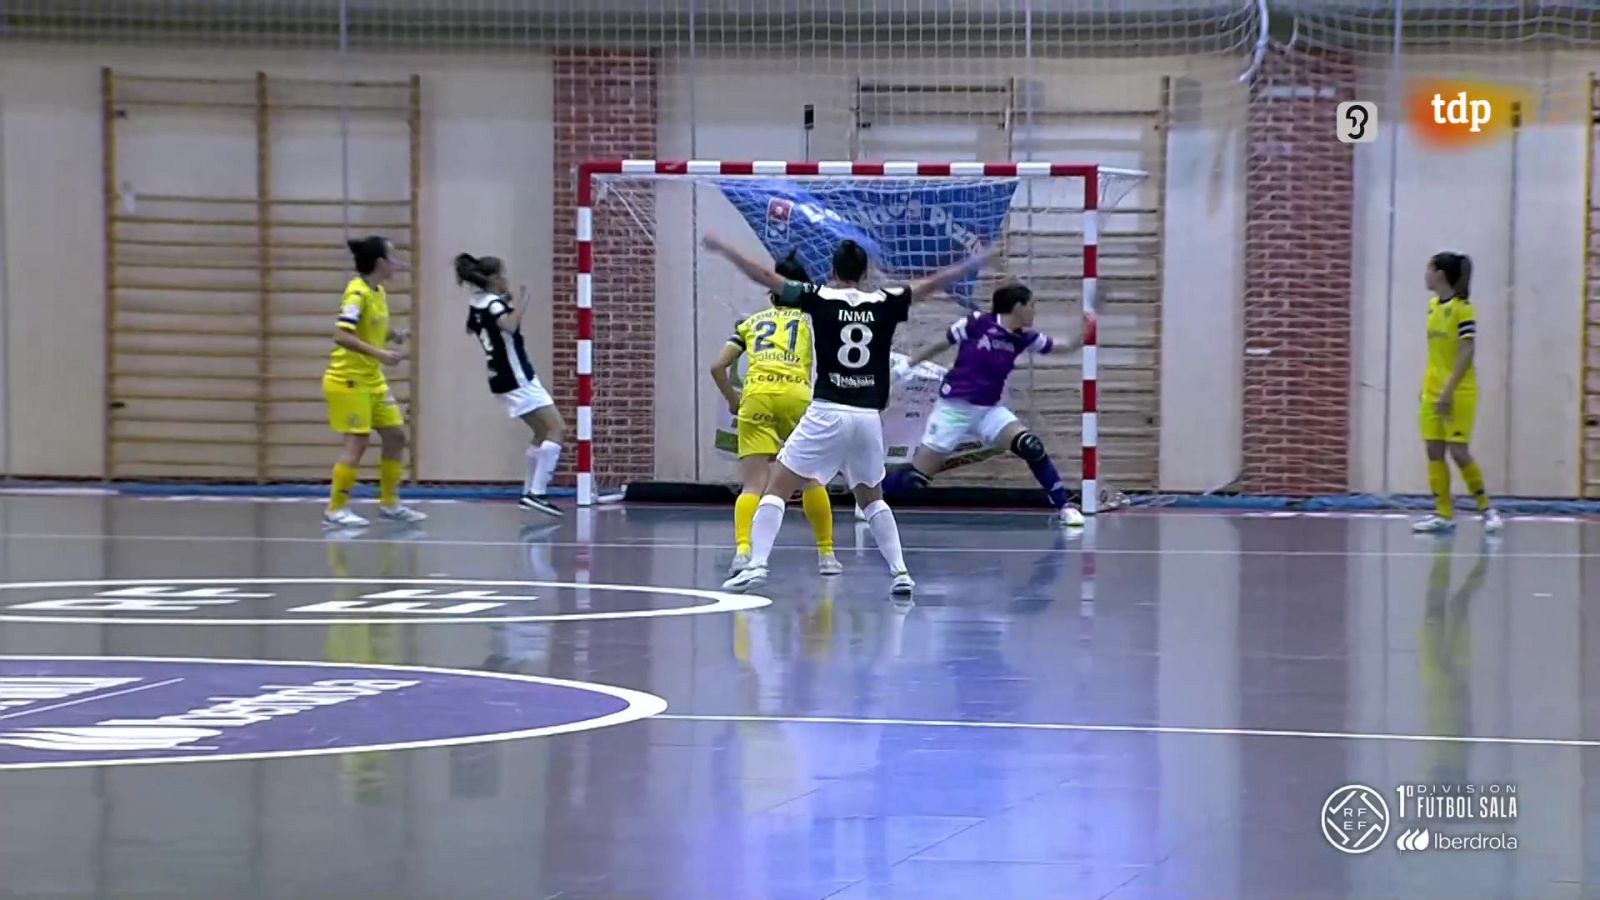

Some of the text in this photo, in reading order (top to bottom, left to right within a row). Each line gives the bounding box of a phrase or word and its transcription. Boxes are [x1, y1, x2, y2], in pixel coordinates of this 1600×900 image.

[838, 309, 875, 323] INMA
[753, 319, 798, 353] 21
[837, 323, 873, 368] 8
